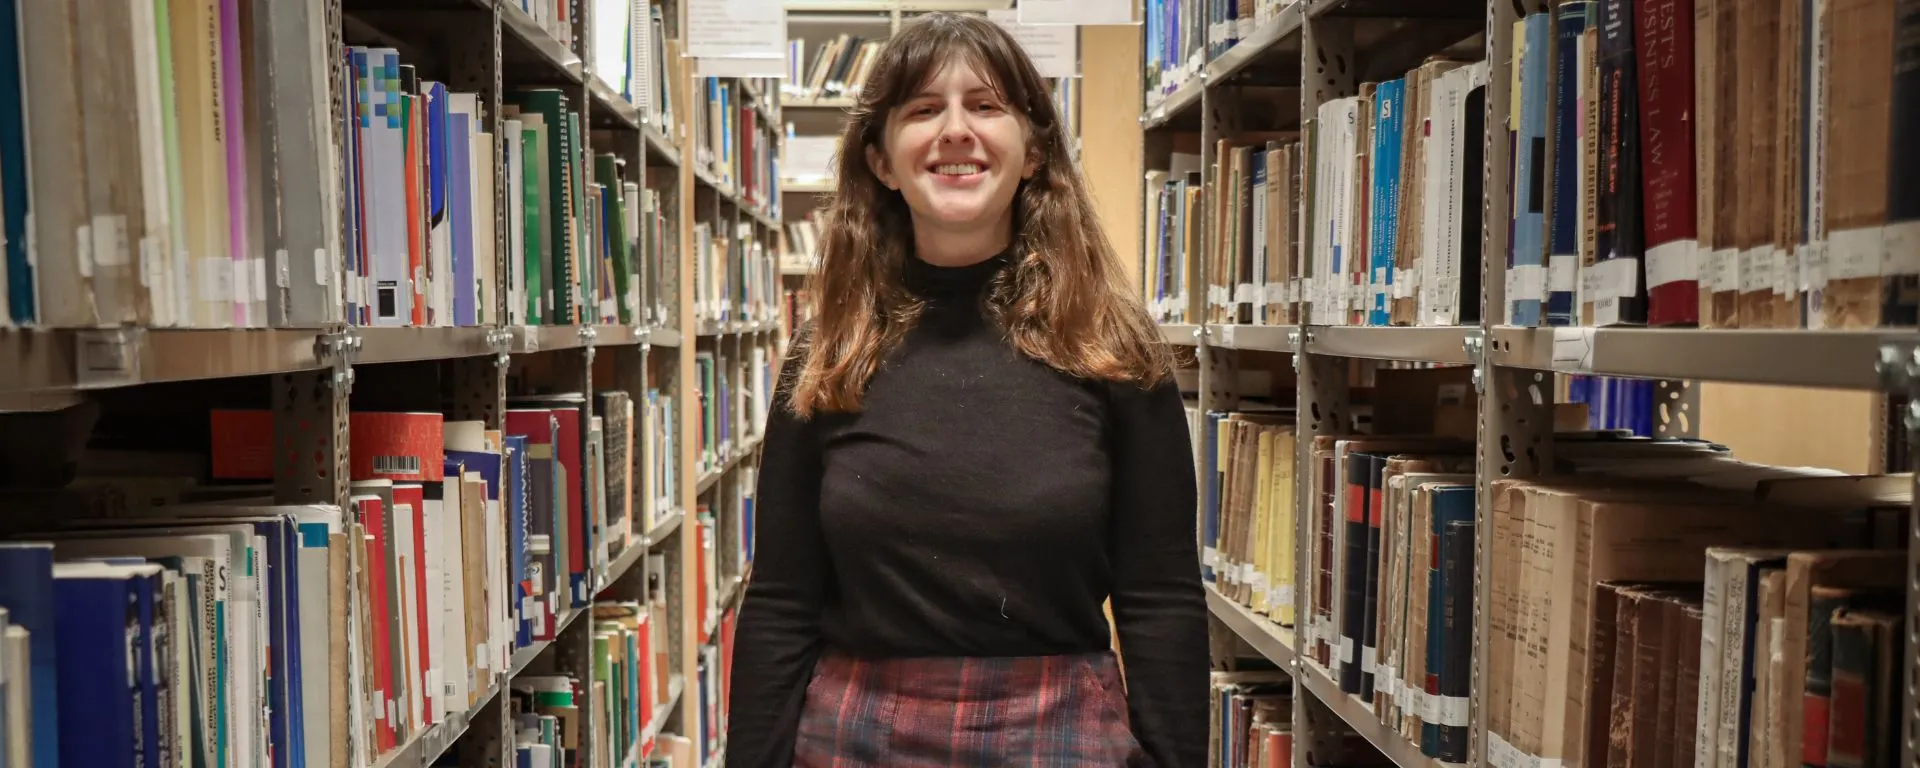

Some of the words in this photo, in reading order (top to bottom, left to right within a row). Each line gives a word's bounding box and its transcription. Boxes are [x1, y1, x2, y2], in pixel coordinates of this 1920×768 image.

[1610, 68, 1622, 159] Commercial
[1648, 110, 1663, 166] LAW
[218, 566, 226, 590] S
[1733, 580, 1743, 650] COMERCIAL
